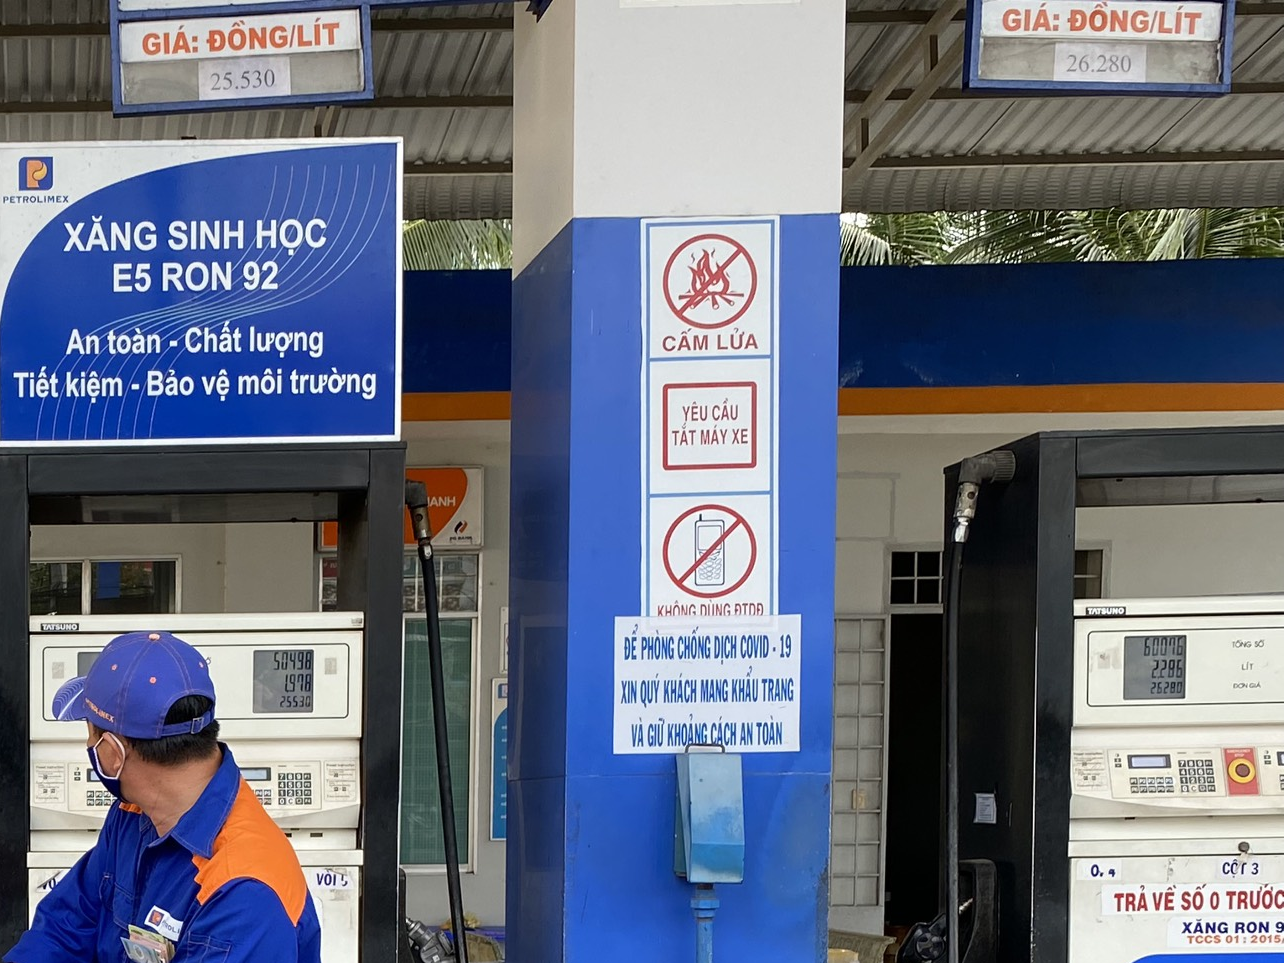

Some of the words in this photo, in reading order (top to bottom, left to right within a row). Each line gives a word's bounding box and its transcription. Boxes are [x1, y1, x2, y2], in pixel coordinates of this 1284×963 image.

[1002, 3, 1060, 32] GIÁ:
[1067, 1, 1202, 35] ĐỒNG/LÍT
[142, 25, 199, 56] GIÁ:
[206, 17, 340, 53] ĐỒNG/LÍT
[1066, 54, 1132, 74] 26.280
[210, 69, 276, 92] 25.530
[2, 195, 69, 204] PETROLIMEX
[63, 215, 158, 252] XĂNG
[168, 220, 245, 250] SINH
[255, 218, 327, 256] HỌC
[112, 262, 152, 293] E5
[162, 262, 232, 292] RON
[242, 260, 279, 290] 92
[66, 329, 100, 355] An
[107, 327, 161, 354] toàn
[185, 321, 241, 353] Chất
[249, 326, 324, 358] lượng
[662, 328, 708, 351] CẤM
[717, 328, 758, 350] LỬA
[13, 366, 58, 399] Tiết
[66, 370, 123, 403] kiệm
[147, 369, 198, 397] Bảo
[202, 370, 230, 401] vệ
[238, 369, 282, 395] môi
[290, 366, 377, 399] trường
[682, 401, 708, 421] YÊU
[712, 398, 739, 421] CẦU
[672, 422, 697, 446] TẮT
[700, 424, 728, 446] MÁY
[732, 428, 748, 445] XE
[657, 601, 696, 617] KHÔNG
[700, 600, 730, 616] DÙNG
[1087, 607, 1125, 615] TATSUNO
[624, 624, 638, 660] ĐỂ
[641, 630, 674, 660] PHÒNG
[677, 627, 710, 660] CHỐNG
[714, 635, 737, 665] DỊCH
[740, 634, 769, 660] COVID
[780, 634, 792, 658] 19
[1144, 636, 1183, 656] 60076
[274, 651, 312, 670] 50498
[1241, 662, 1254, 671] LÍT
[621, 680, 637, 704] XIN
[640, 673, 660, 708] QUÝ
[663, 673, 697, 704] KHÁCH
[701, 679, 729, 703] MANG
[731, 666, 758, 703] KHẨU
[762, 678, 794, 702] TRANG
[1150, 681, 1183, 694] 26280
[280, 696, 311, 708] 25530
[631, 717, 644, 747] VÀ
[647, 717, 664, 747] GIỮ
[668, 714, 707, 747] KHOẢNG
[710, 715, 737, 746] CÁCH
[740, 722, 753, 746] AN
[756, 715, 782, 745] TOÀN
[1251, 862, 1259, 875] 3
[1114, 885, 1149, 912] TRẢ
[1153, 885, 1177, 911] VỀ
[1181, 884, 1207, 911] SỐ
[1226, 884, 1284, 910] TRƯỚC
[1182, 919, 1229, 934] XĂNG
[1234, 921, 1270, 934] RON
[1187, 935, 1222, 944] TCCS
[1225, 935, 1238, 944] 01
